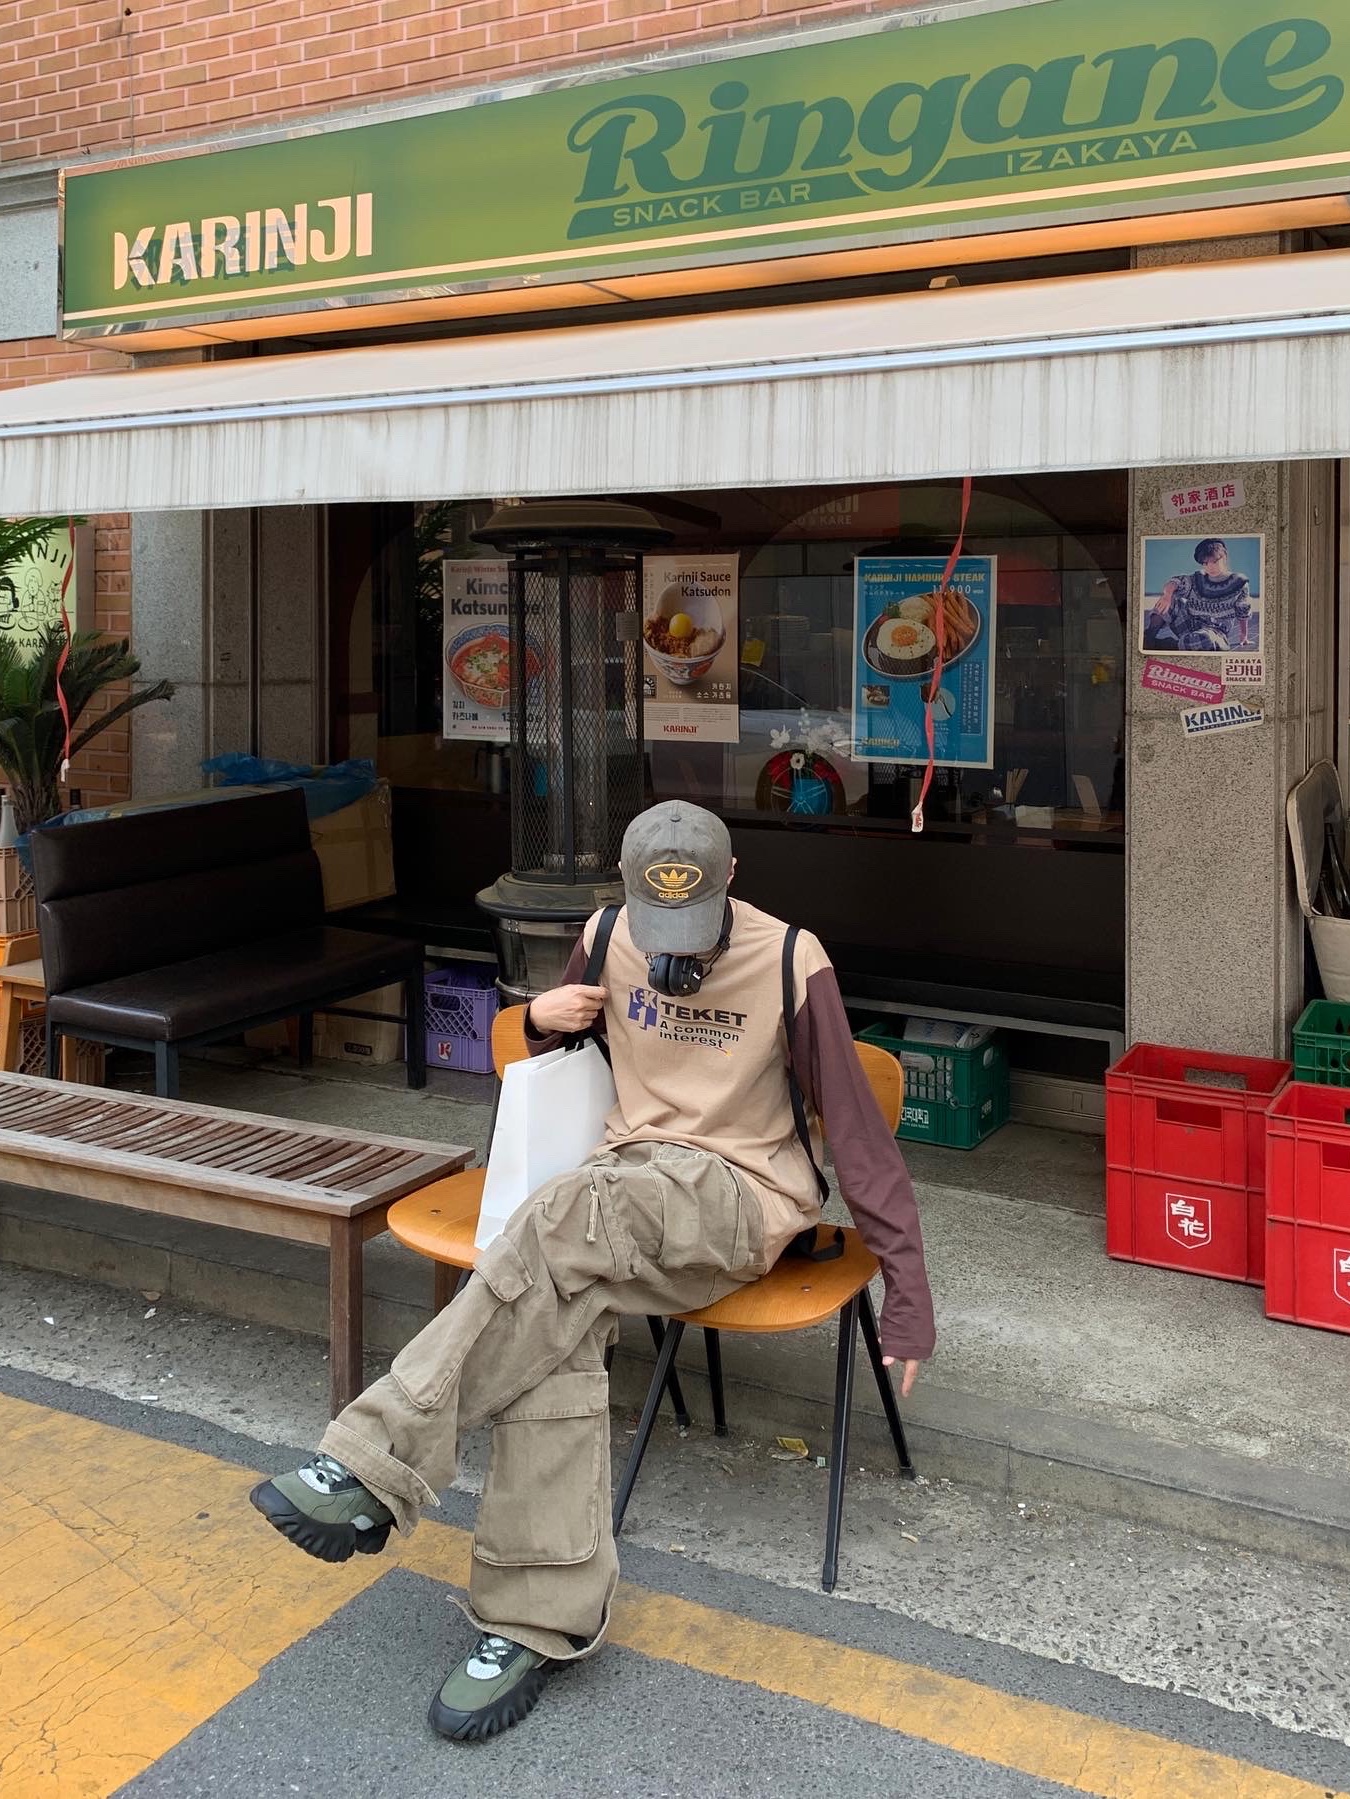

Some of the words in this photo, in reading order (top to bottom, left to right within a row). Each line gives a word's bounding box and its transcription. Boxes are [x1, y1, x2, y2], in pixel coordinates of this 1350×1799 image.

[567, 17, 1344, 204] Ringane
[1007, 130, 1198, 174] IZAKAYA
[614, 195, 723, 227] SNACK
[739, 182, 811, 210] BAR
[114, 193, 373, 290] KARINJI
[1179, 504, 1209, 515] SNACK
[1211, 500, 1230, 509] BAR
[664, 571, 698, 584] Karinji
[700, 571, 731, 582] Sauce
[954, 573, 985, 582] STEAK
[681, 586, 731, 597] Katsudon
[1146, 664, 1222, 692] Ringane
[1225, 665, 1262, 676] 린가네
[1151, 681, 1187, 694] SNACK
[1190, 690, 1214, 700] BAR
[1185, 705, 1261, 727] KARIN
[663, 725, 698, 733] KARINJI
[658, 891, 690, 900] adidas
[660, 1001, 748, 1027] TEKET
[660, 1021, 669, 1030] A
[674, 1025, 740, 1042] common
[660, 1029, 724, 1048] interest
